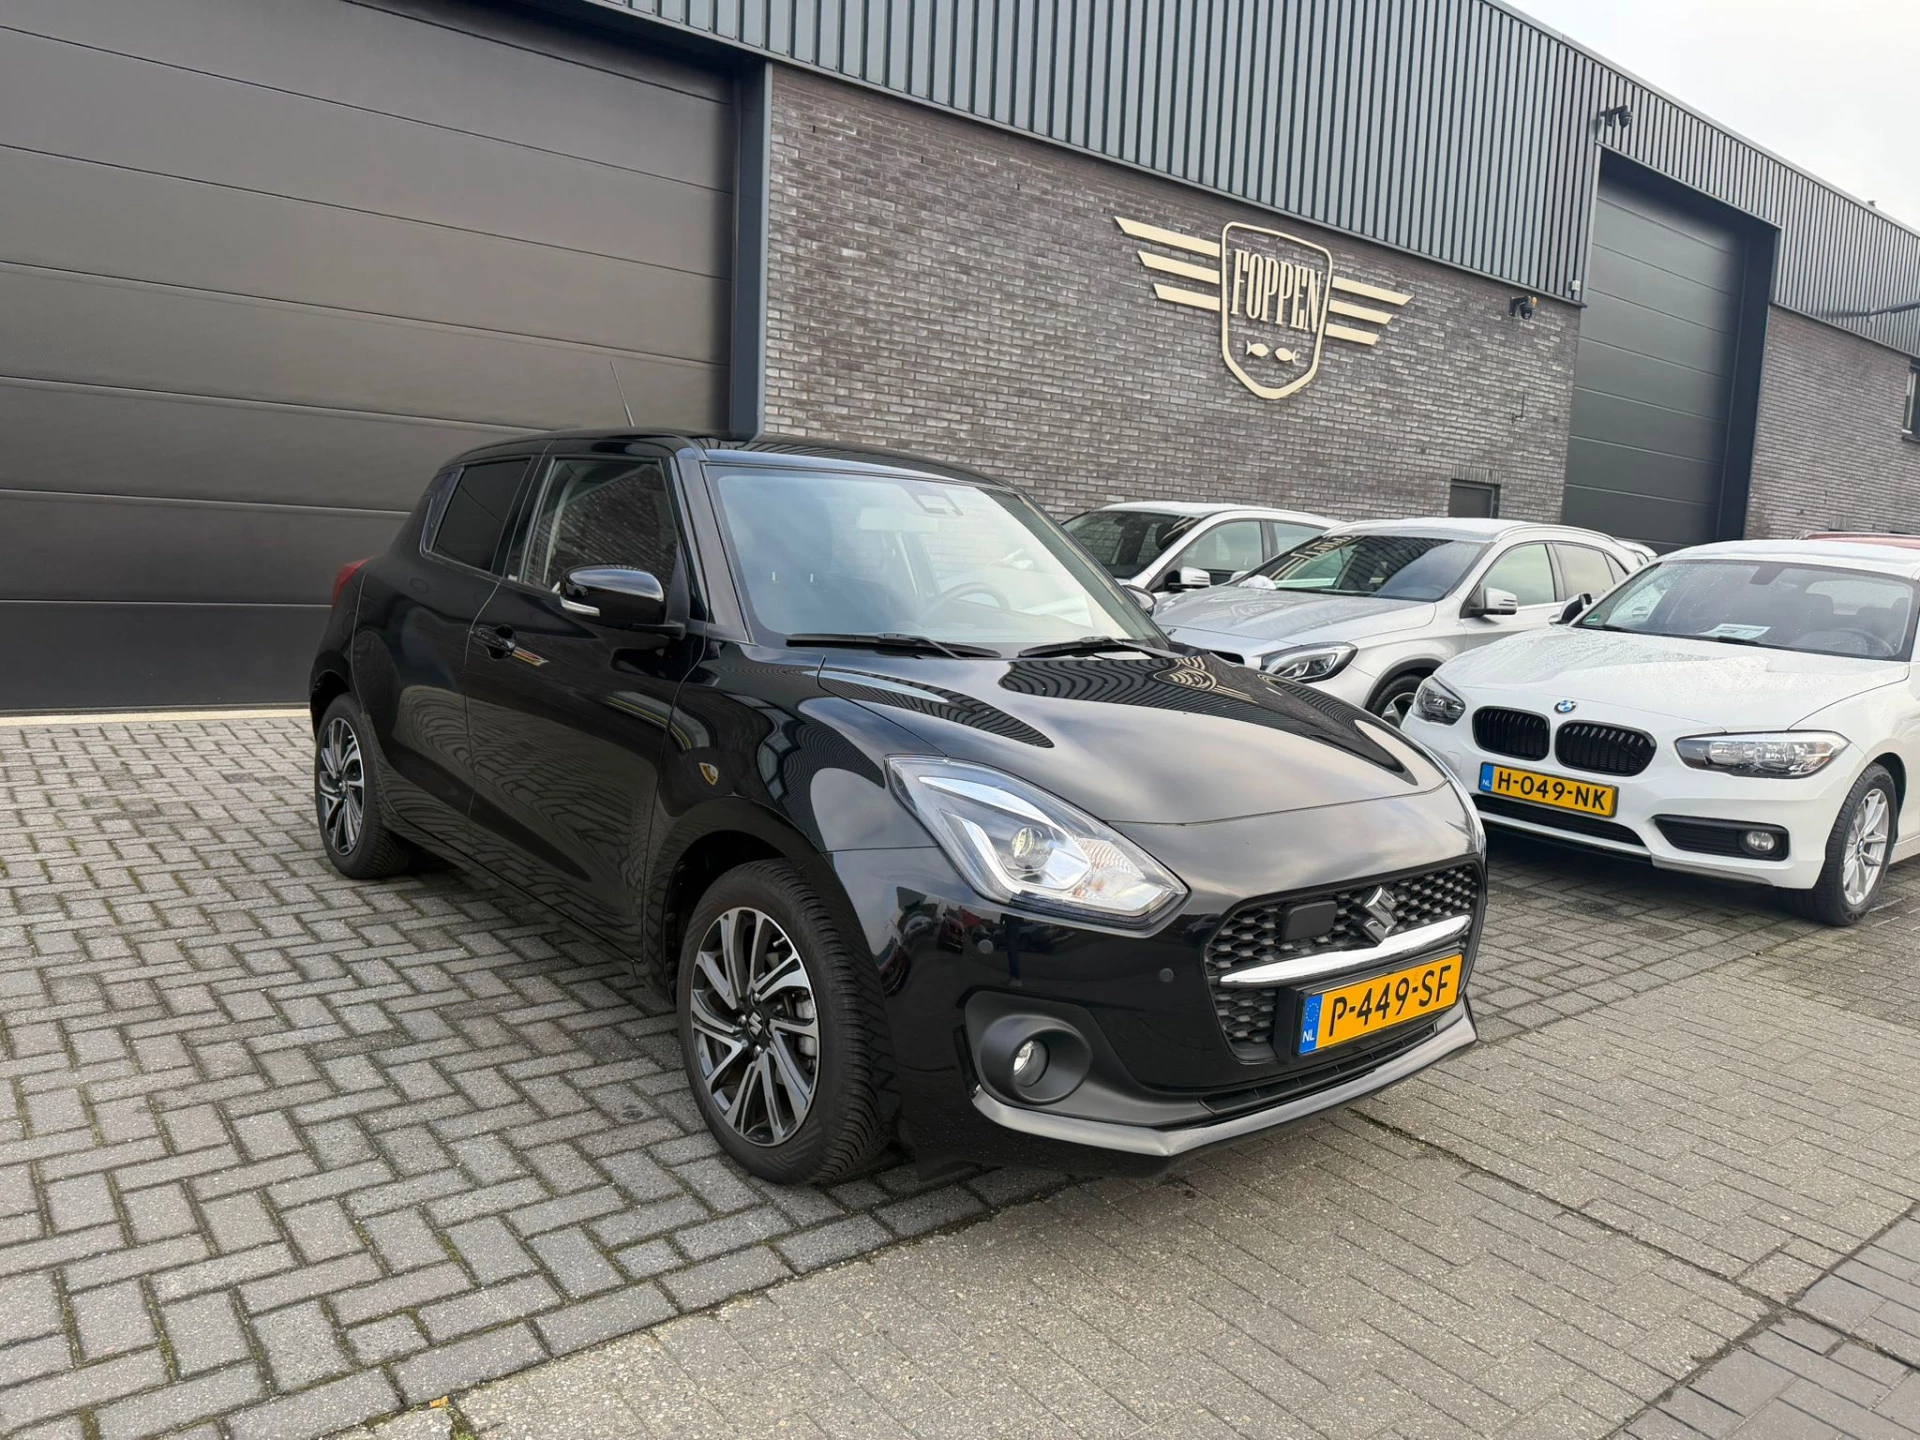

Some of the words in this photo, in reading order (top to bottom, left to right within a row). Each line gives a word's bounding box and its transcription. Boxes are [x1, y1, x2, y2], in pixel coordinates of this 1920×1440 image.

[1230, 249, 1322, 332] FOPPEN
[1482, 779, 1491, 787] NL
[1498, 771, 1607, 811] H-049-NK
[1302, 1030, 1315, 1043] NL
[1328, 964, 1452, 1037] P-449-SF
